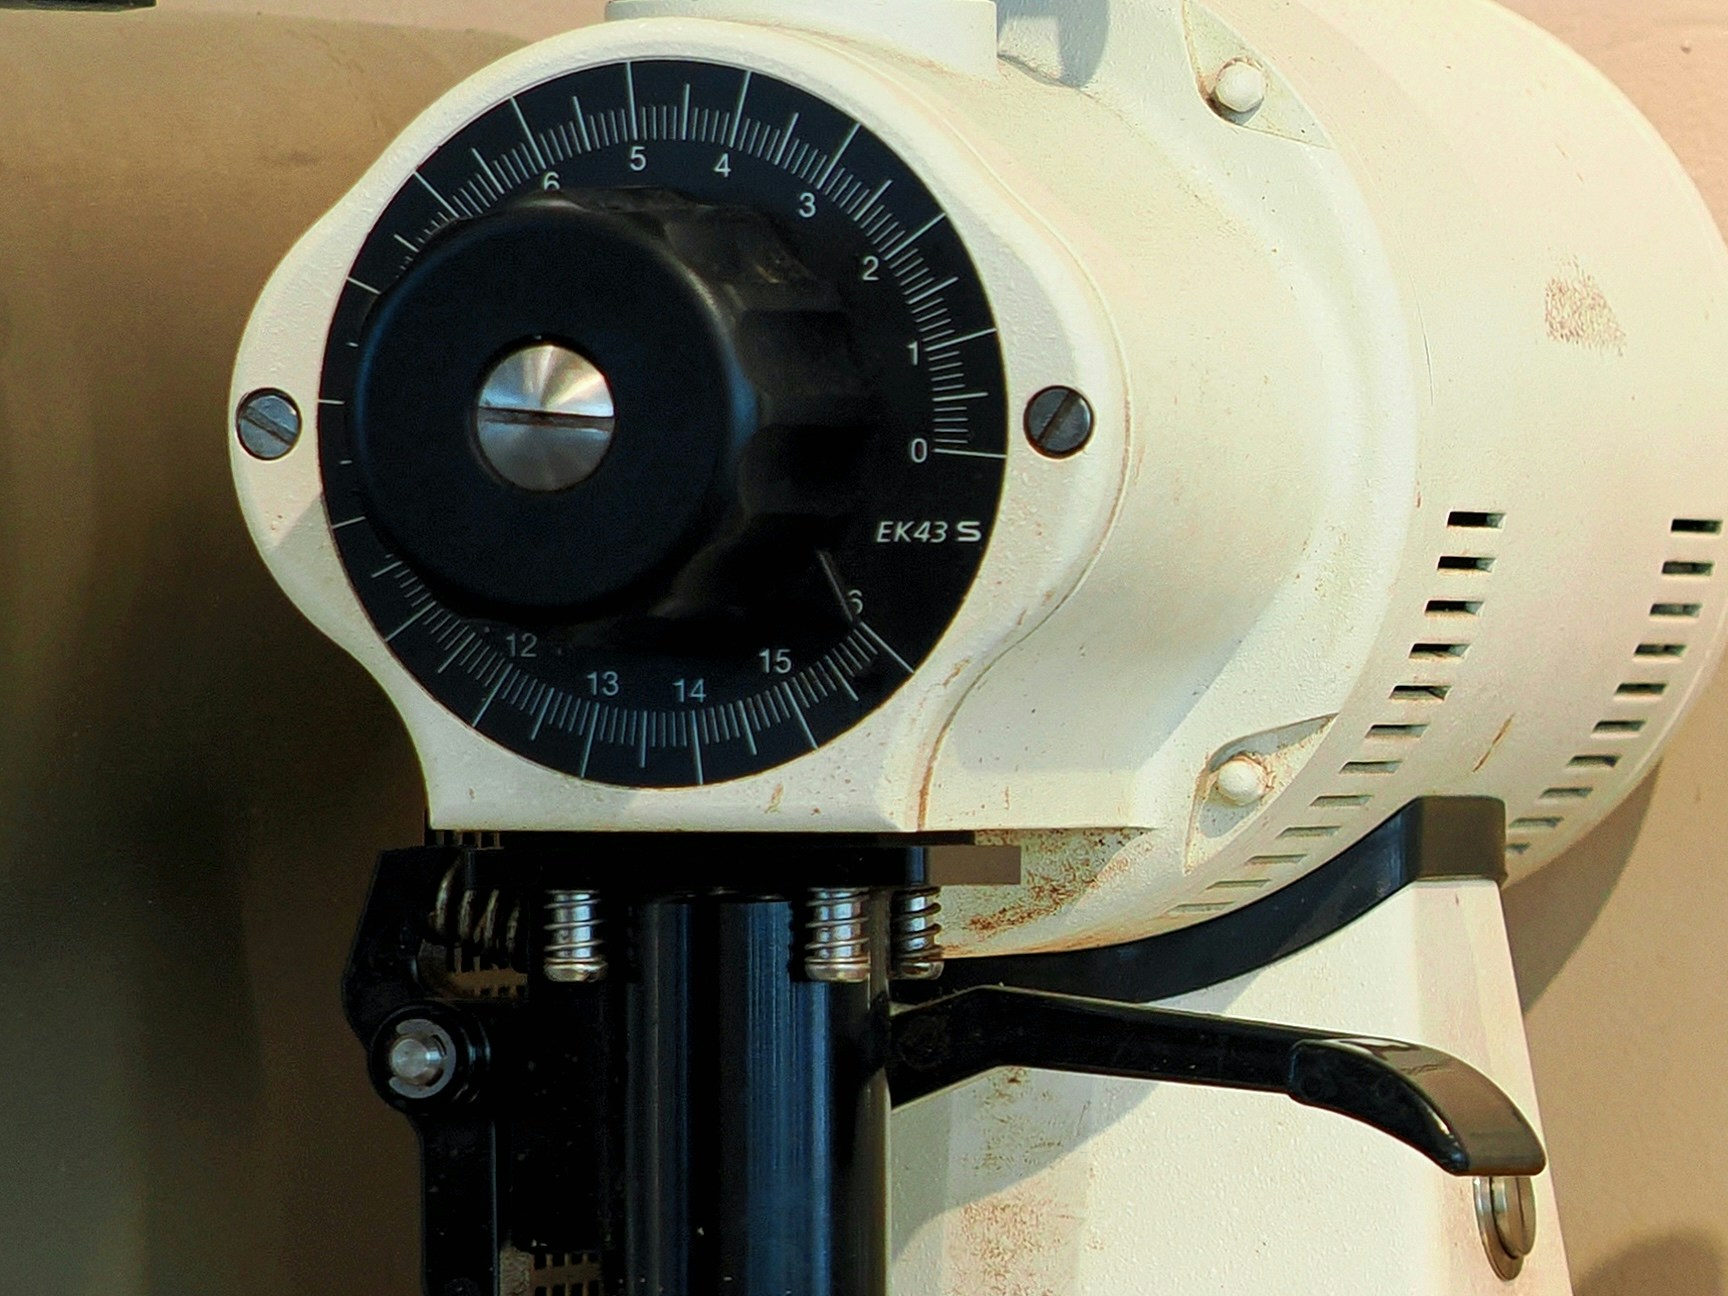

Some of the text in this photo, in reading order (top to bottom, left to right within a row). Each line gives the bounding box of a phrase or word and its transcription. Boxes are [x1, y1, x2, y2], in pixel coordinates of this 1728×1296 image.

[629, 146, 647, 171] 5
[714, 153, 731, 178] 4
[799, 192, 816, 218] 3
[862, 256, 880, 281] 2
[906, 340, 919, 366] 1
[911, 437, 928, 463] 0
[876, 521, 982, 543] EK43 S
[505, 632, 538, 658] 12
[758, 648, 792, 674] 15
[586, 670, 620, 697] 13
[672, 678, 707, 704] 14
